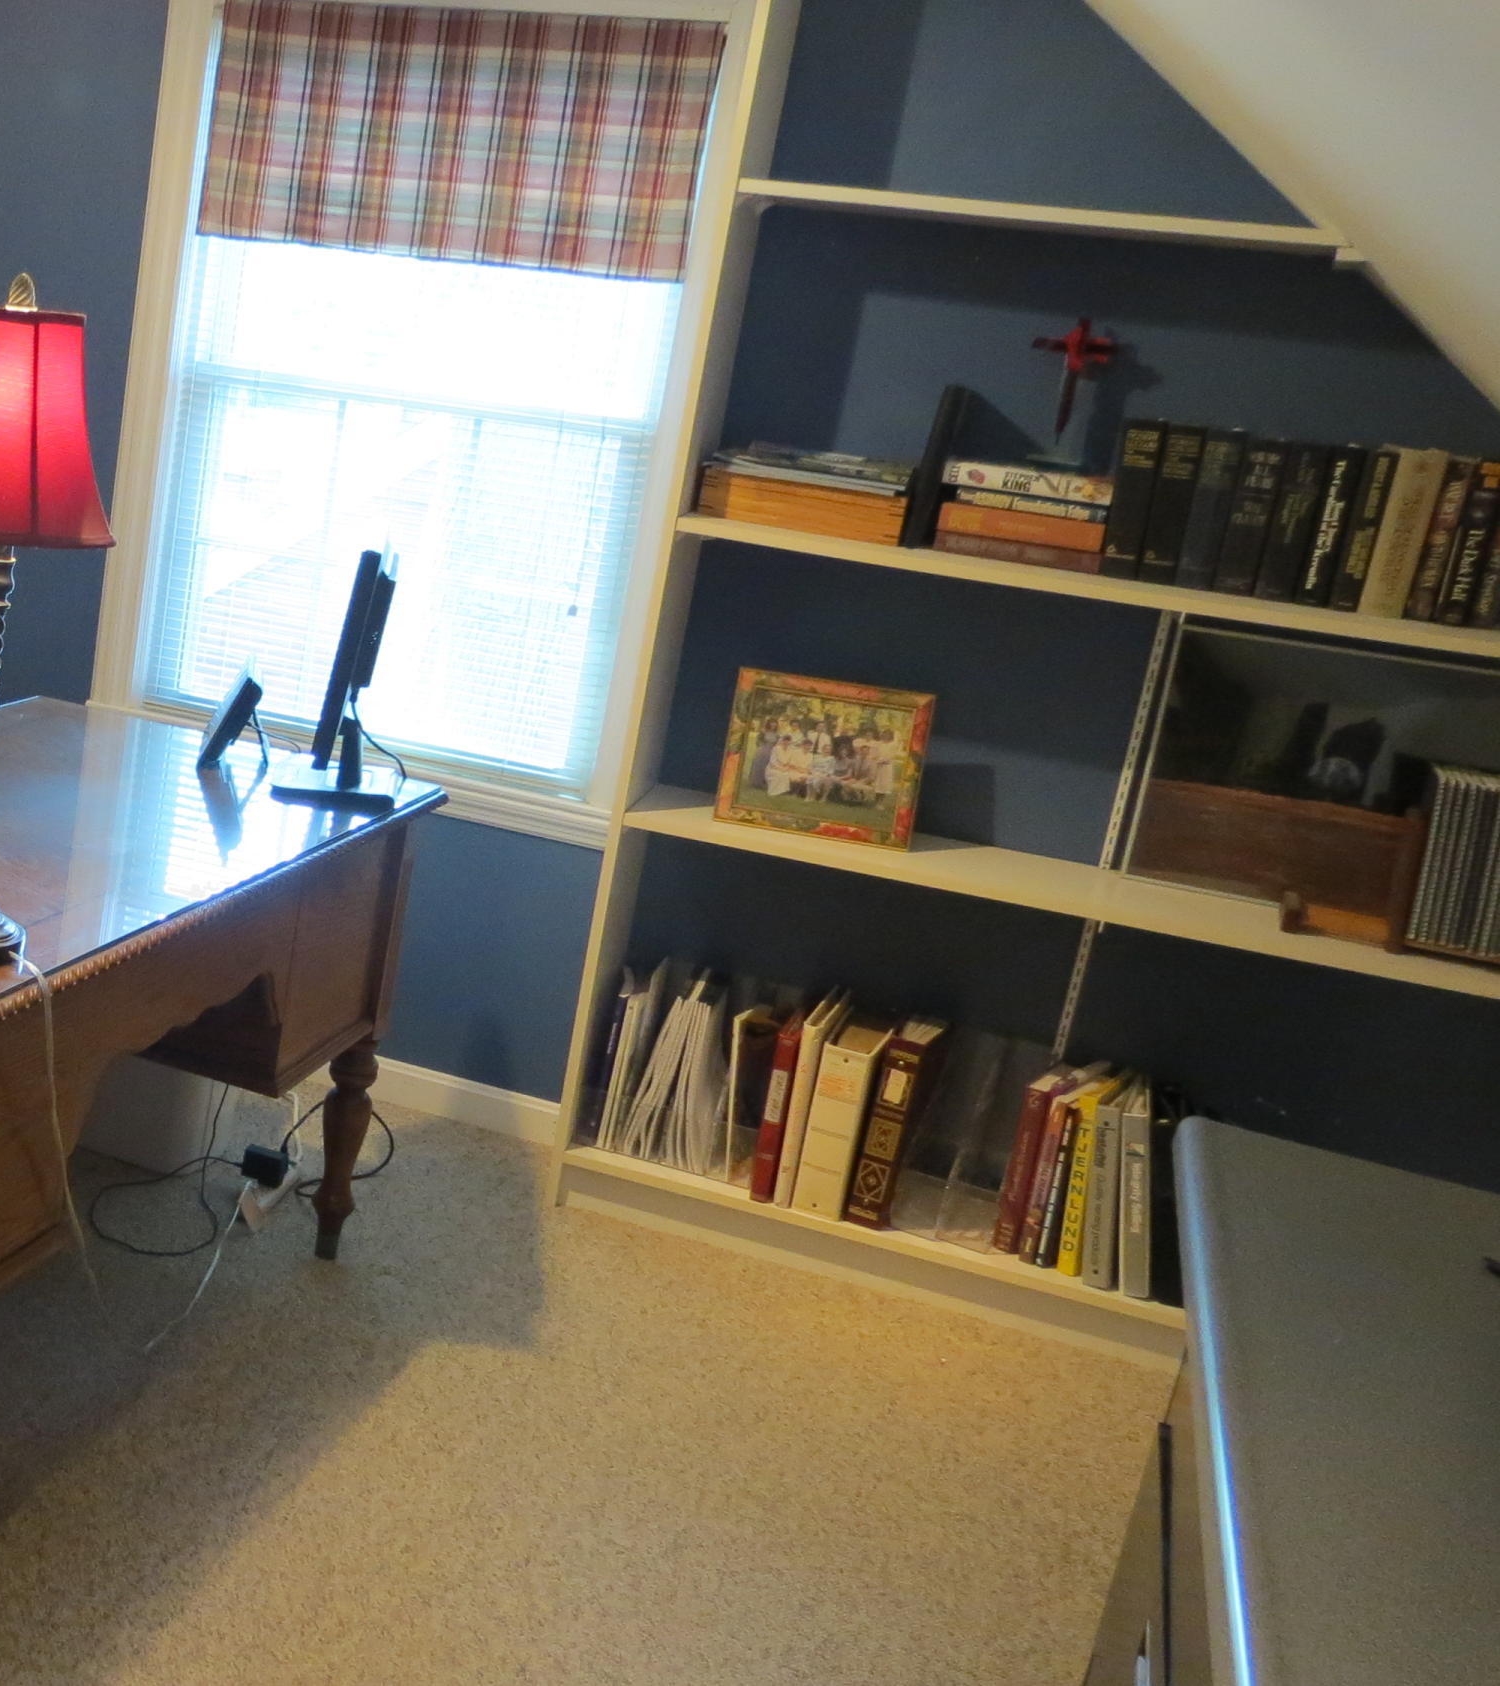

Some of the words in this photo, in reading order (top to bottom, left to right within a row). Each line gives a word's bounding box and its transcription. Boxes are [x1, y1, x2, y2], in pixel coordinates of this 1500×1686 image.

[1001, 479, 1032, 492] KING
[1004, 471, 1041, 483] STEPHEN
[1457, 549, 1480, 573] Dark
[1450, 575, 1474, 601] Half
[1129, 1162, 1143, 1202] Integrity
